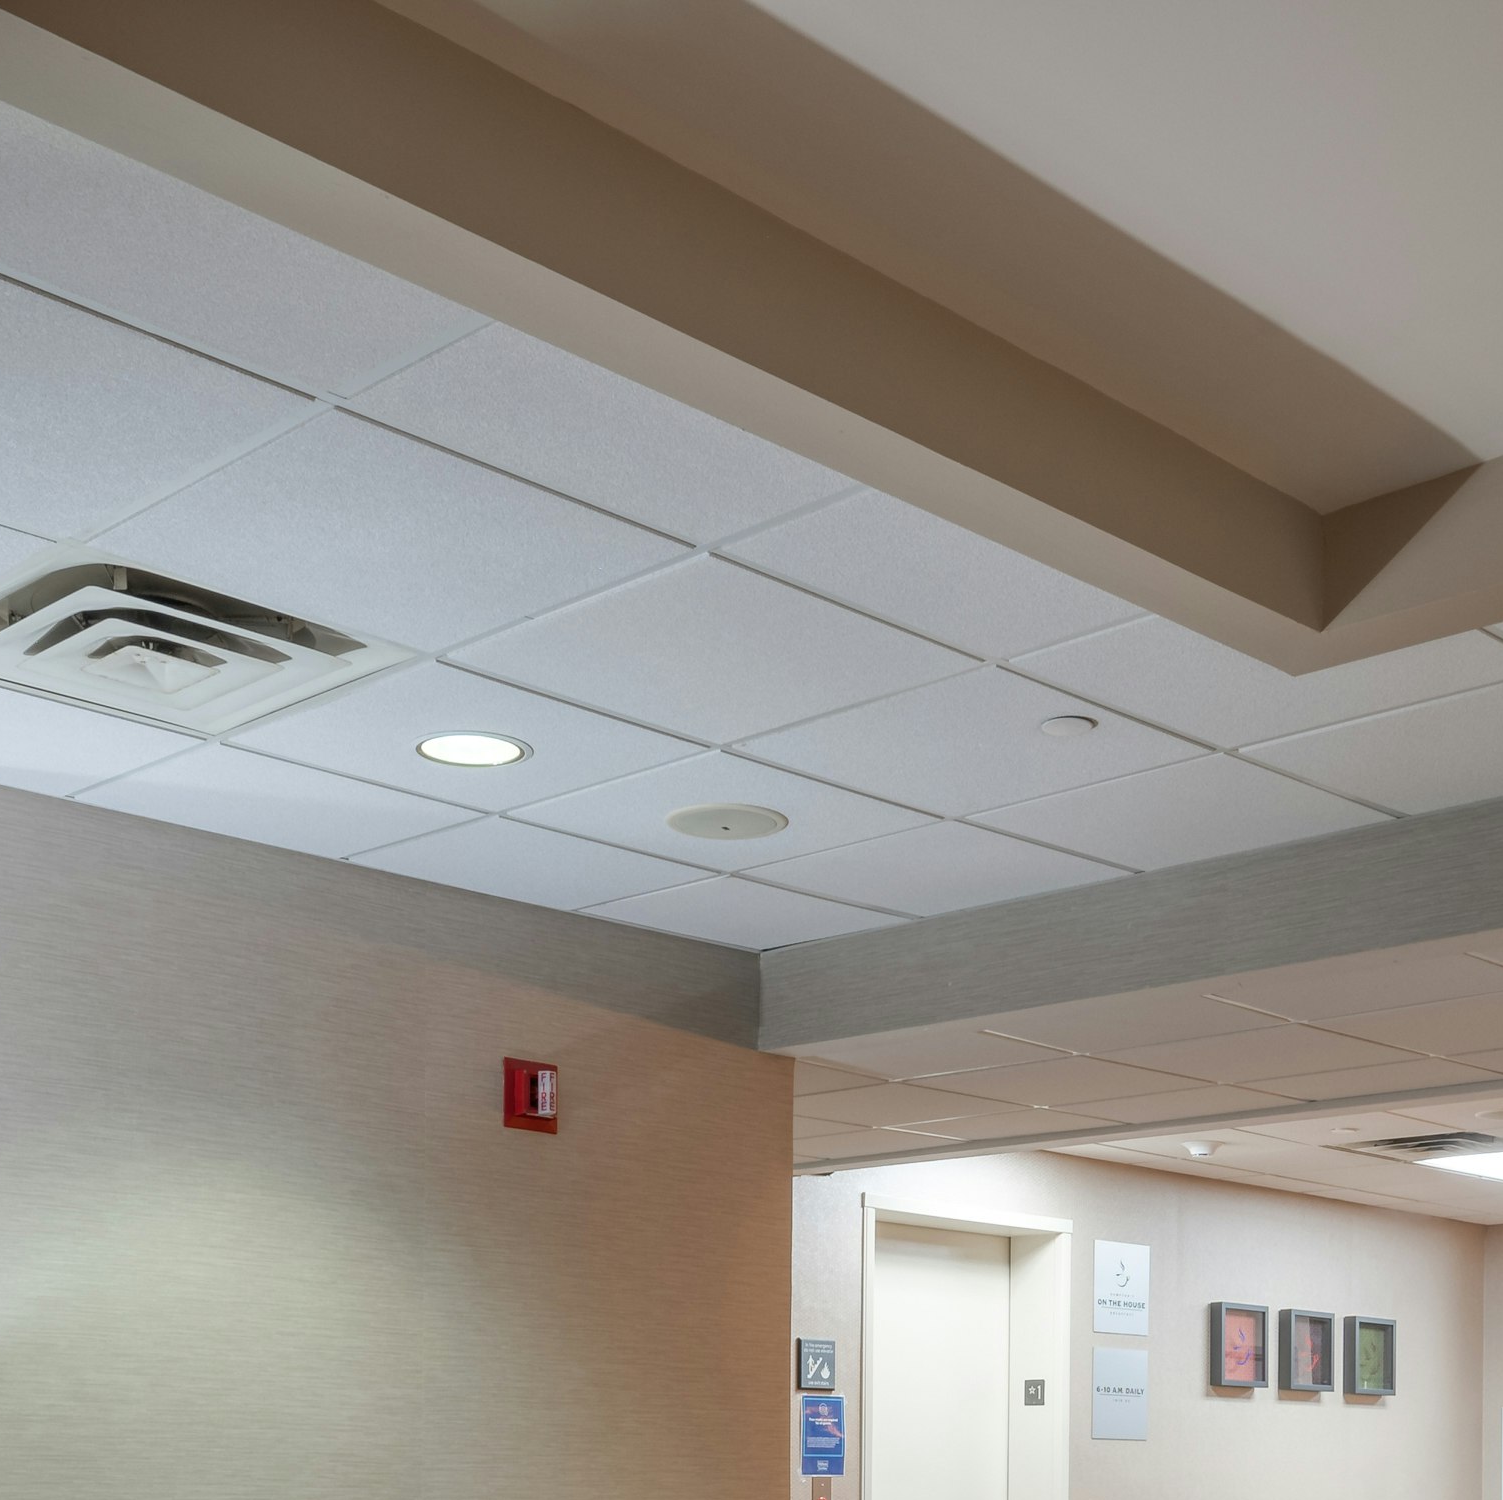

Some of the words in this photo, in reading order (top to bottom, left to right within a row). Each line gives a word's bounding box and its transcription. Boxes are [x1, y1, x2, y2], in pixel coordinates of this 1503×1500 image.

[1109, 1299, 1122, 1307] THE
[1123, 1301, 1146, 1310] HOUSE
[1125, 1387, 1145, 1395] DAILY
